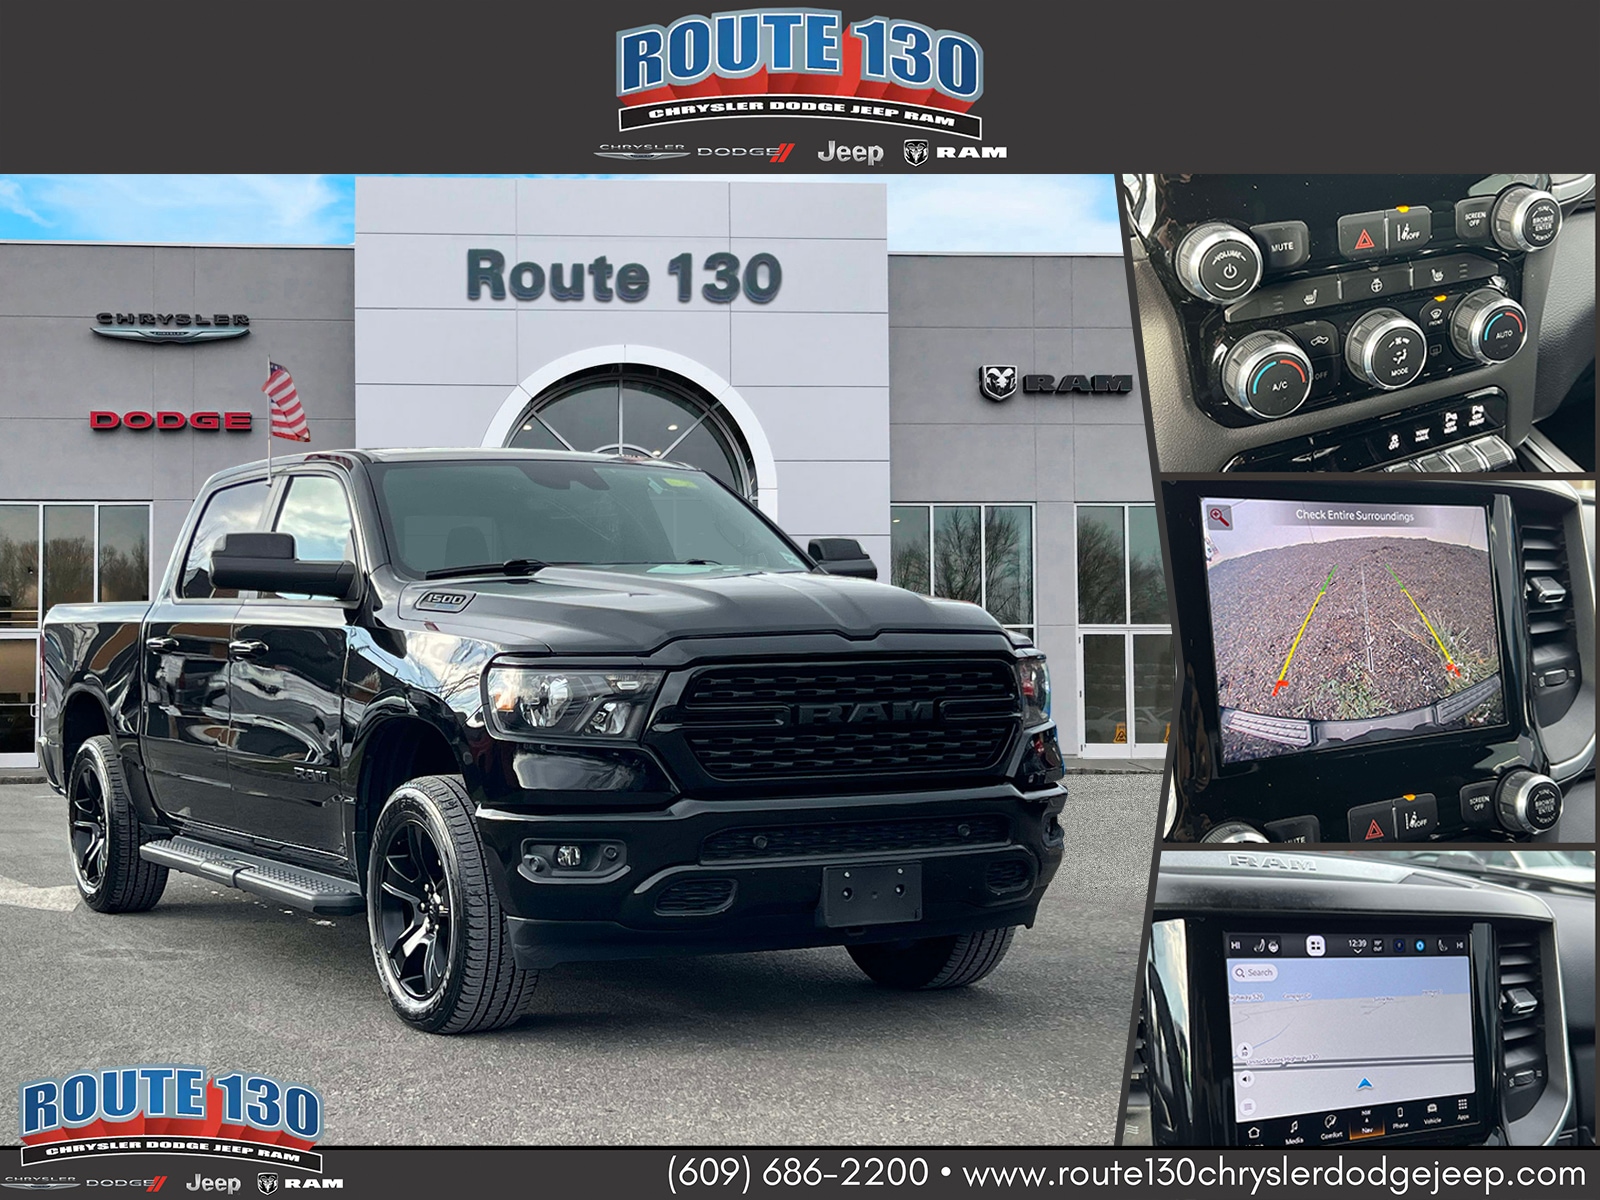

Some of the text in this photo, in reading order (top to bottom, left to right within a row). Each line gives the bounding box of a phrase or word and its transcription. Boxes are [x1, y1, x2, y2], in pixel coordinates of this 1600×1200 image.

[1464, 211, 1487, 222] SCREEN
[1469, 219, 1481, 228] OFF
[1409, 231, 1421, 241] OFF
[1271, 241, 1294, 252] MUTE
[1214, 250, 1243, 262] VOLUME
[467, 248, 783, 304] Route 130
[96, 312, 250, 326] CHRYSLER
[1495, 329, 1513, 340] AUTO
[1314, 371, 1329, 381] OFF
[1390, 366, 1409, 377] MODE
[1022, 374, 1133, 395] RAM
[1272, 381, 1288, 392] A/C
[89, 410, 253, 432] DODGE
[1296, 509, 1415, 523] Check Entire Surroundings
[427, 593, 465, 604] 1500
[799, 701, 934, 725] RAM
[1469, 795, 1490, 805] SCREEN
[1473, 803, 1484, 811] OFF
[1416, 818, 1428, 829] OFF
[1228, 853, 1317, 871] RAM
[1230, 941, 1241, 950] HI
[1348, 939, 1367, 948] 12:39
[1247, 968, 1274, 977] Search
[1320, 1131, 1343, 1141] Comfort
[1392, 1122, 1409, 1130] Phone
[1423, 1116, 1442, 1126] Vehicle
[1457, 1113, 1470, 1122] Apps
[1285, 1137, 1304, 1146] Media
